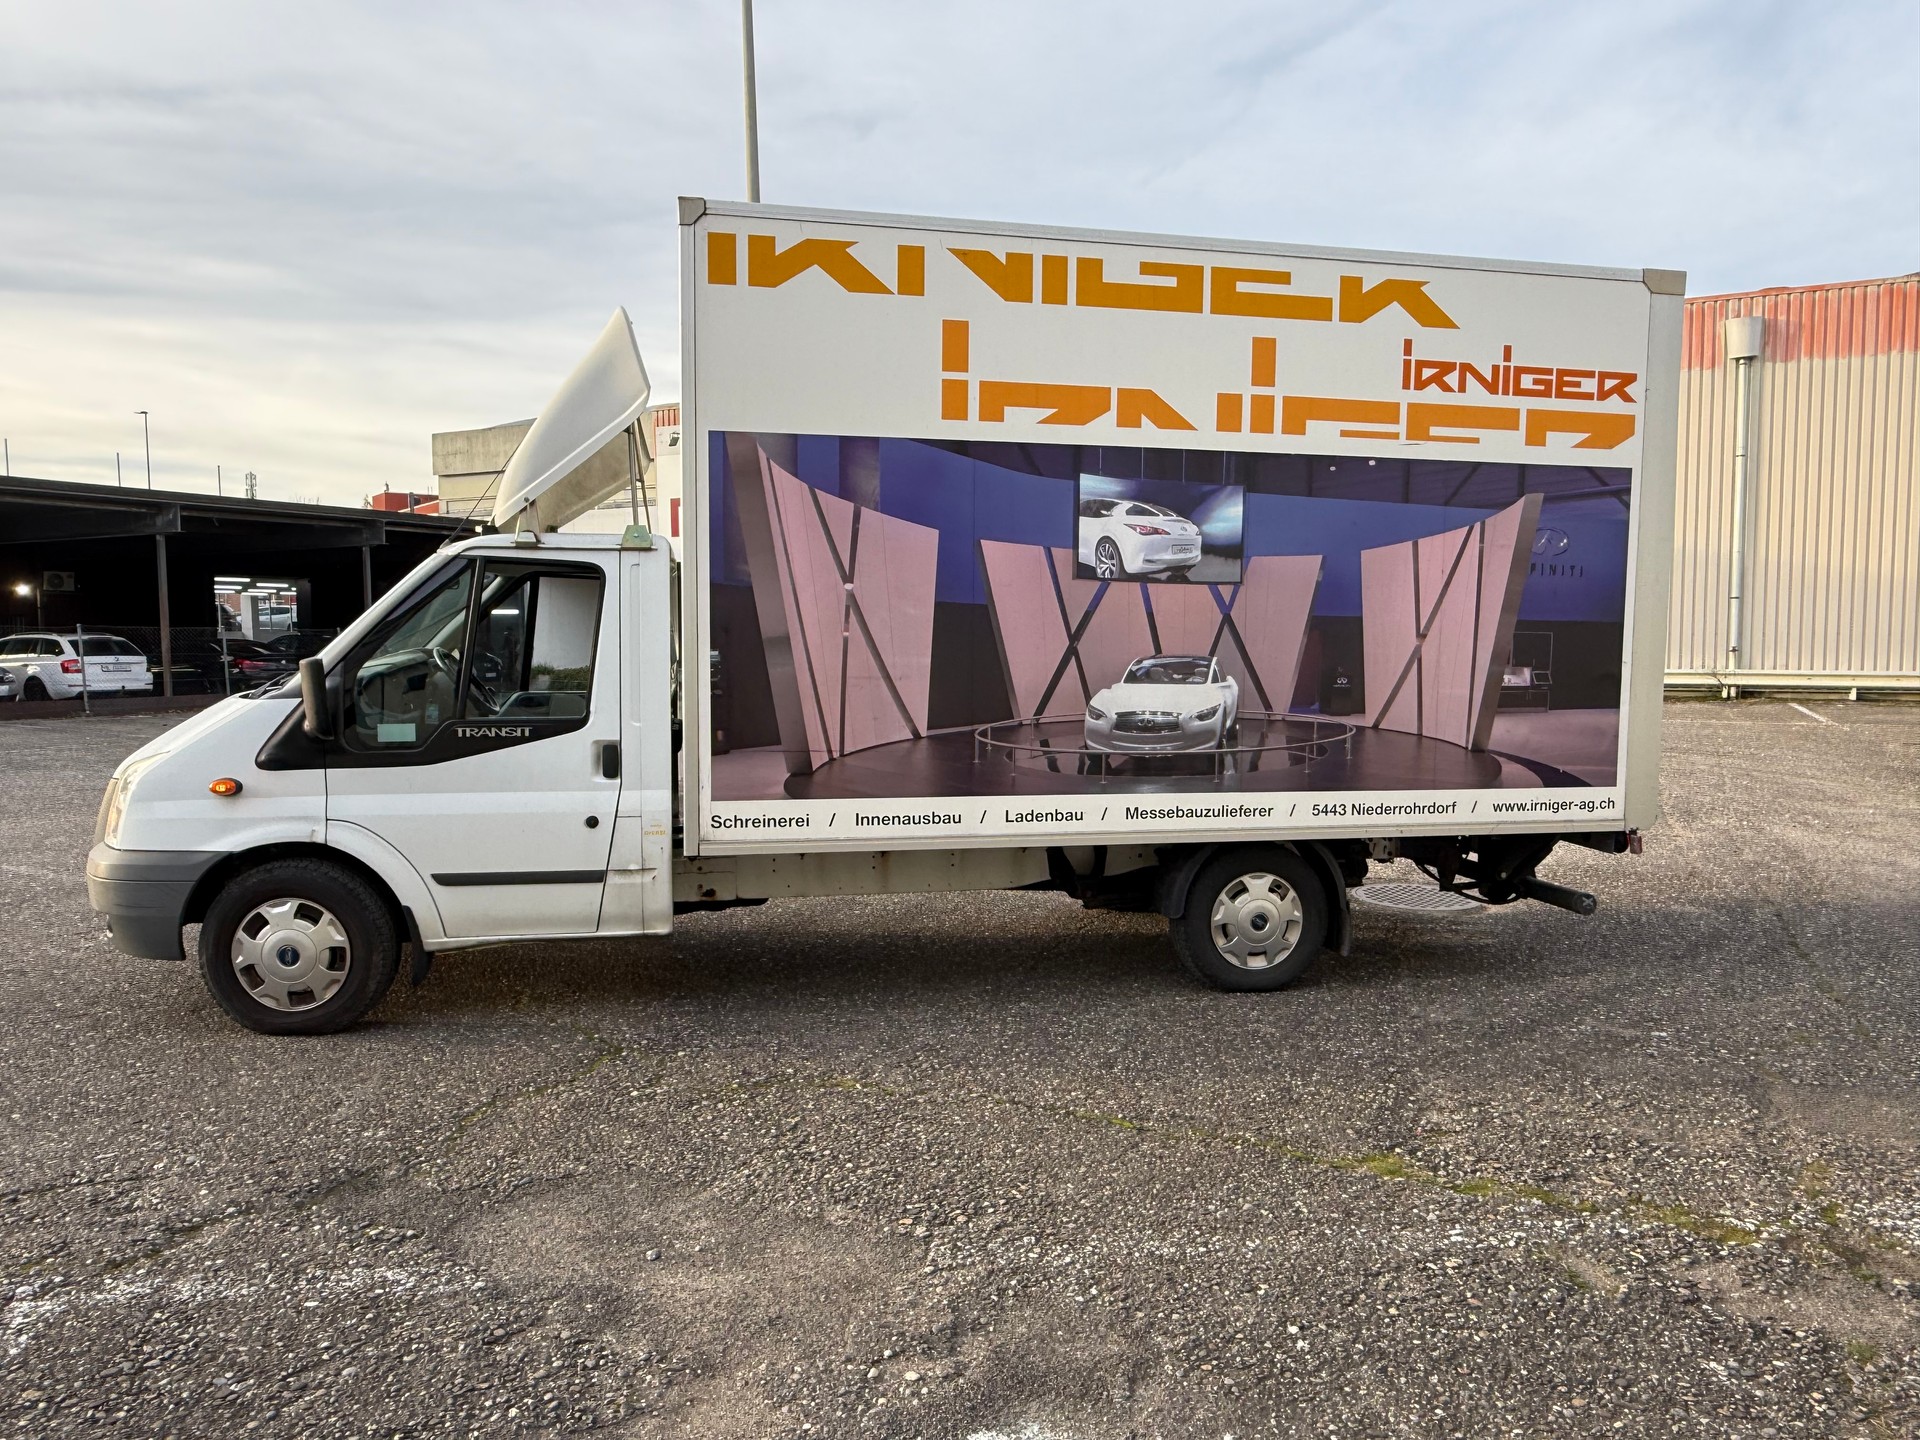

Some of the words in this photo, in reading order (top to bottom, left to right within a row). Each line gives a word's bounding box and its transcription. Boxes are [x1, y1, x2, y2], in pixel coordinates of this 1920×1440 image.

[455, 727, 533, 738] TRANSIT
[711, 814, 810, 829] Schreinerei
[855, 811, 962, 827] Innenausbau
[1005, 809, 1084, 823] Ladenbau
[1125, 805, 1273, 820] Messebauzulieferer
[1311, 803, 1347, 817] 5443
[1351, 801, 1457, 816] Niederrohrdorf
[1492, 797, 1616, 814] www.irniger-ag.ch
